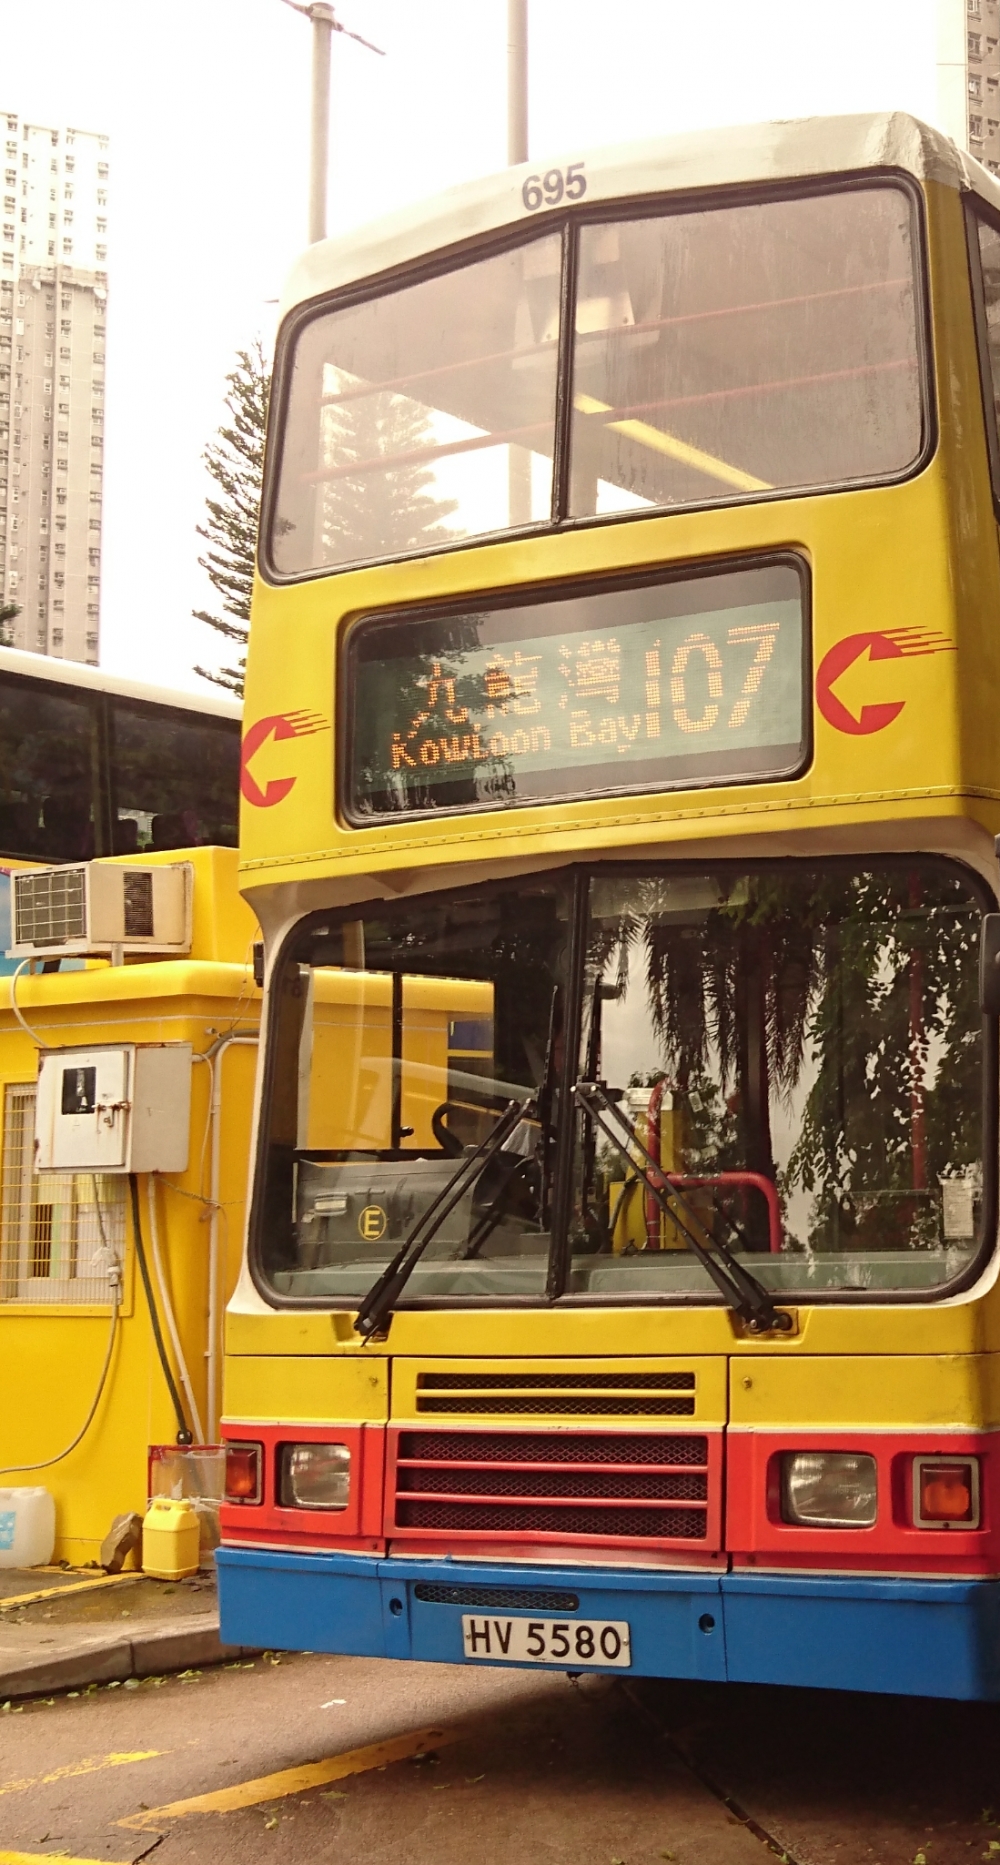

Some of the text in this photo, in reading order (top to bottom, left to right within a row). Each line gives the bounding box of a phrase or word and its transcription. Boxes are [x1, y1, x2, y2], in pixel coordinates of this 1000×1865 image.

[522, 161, 587, 211] 695
[407, 637, 622, 738] 九龍灣
[643, 621, 781, 738] 107
[568, 709, 642, 754] Bay
[470, 1619, 622, 1661] HV 5580
